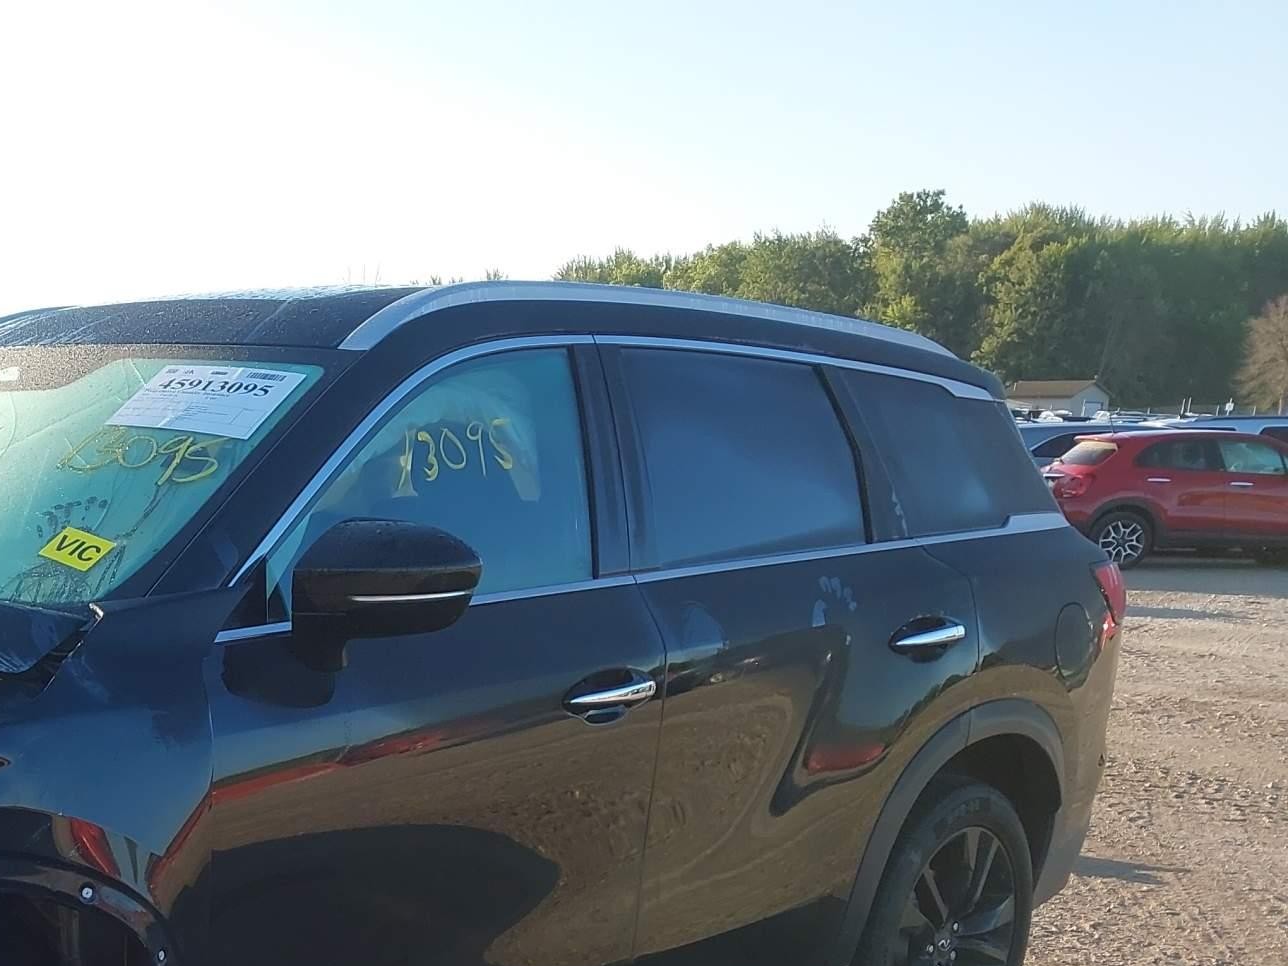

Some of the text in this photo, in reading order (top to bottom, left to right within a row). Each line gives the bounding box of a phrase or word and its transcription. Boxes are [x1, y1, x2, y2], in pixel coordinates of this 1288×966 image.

[159, 378, 275, 397] 45913095
[394, 418, 515, 496] 13095
[55, 534, 102, 562] VIC
